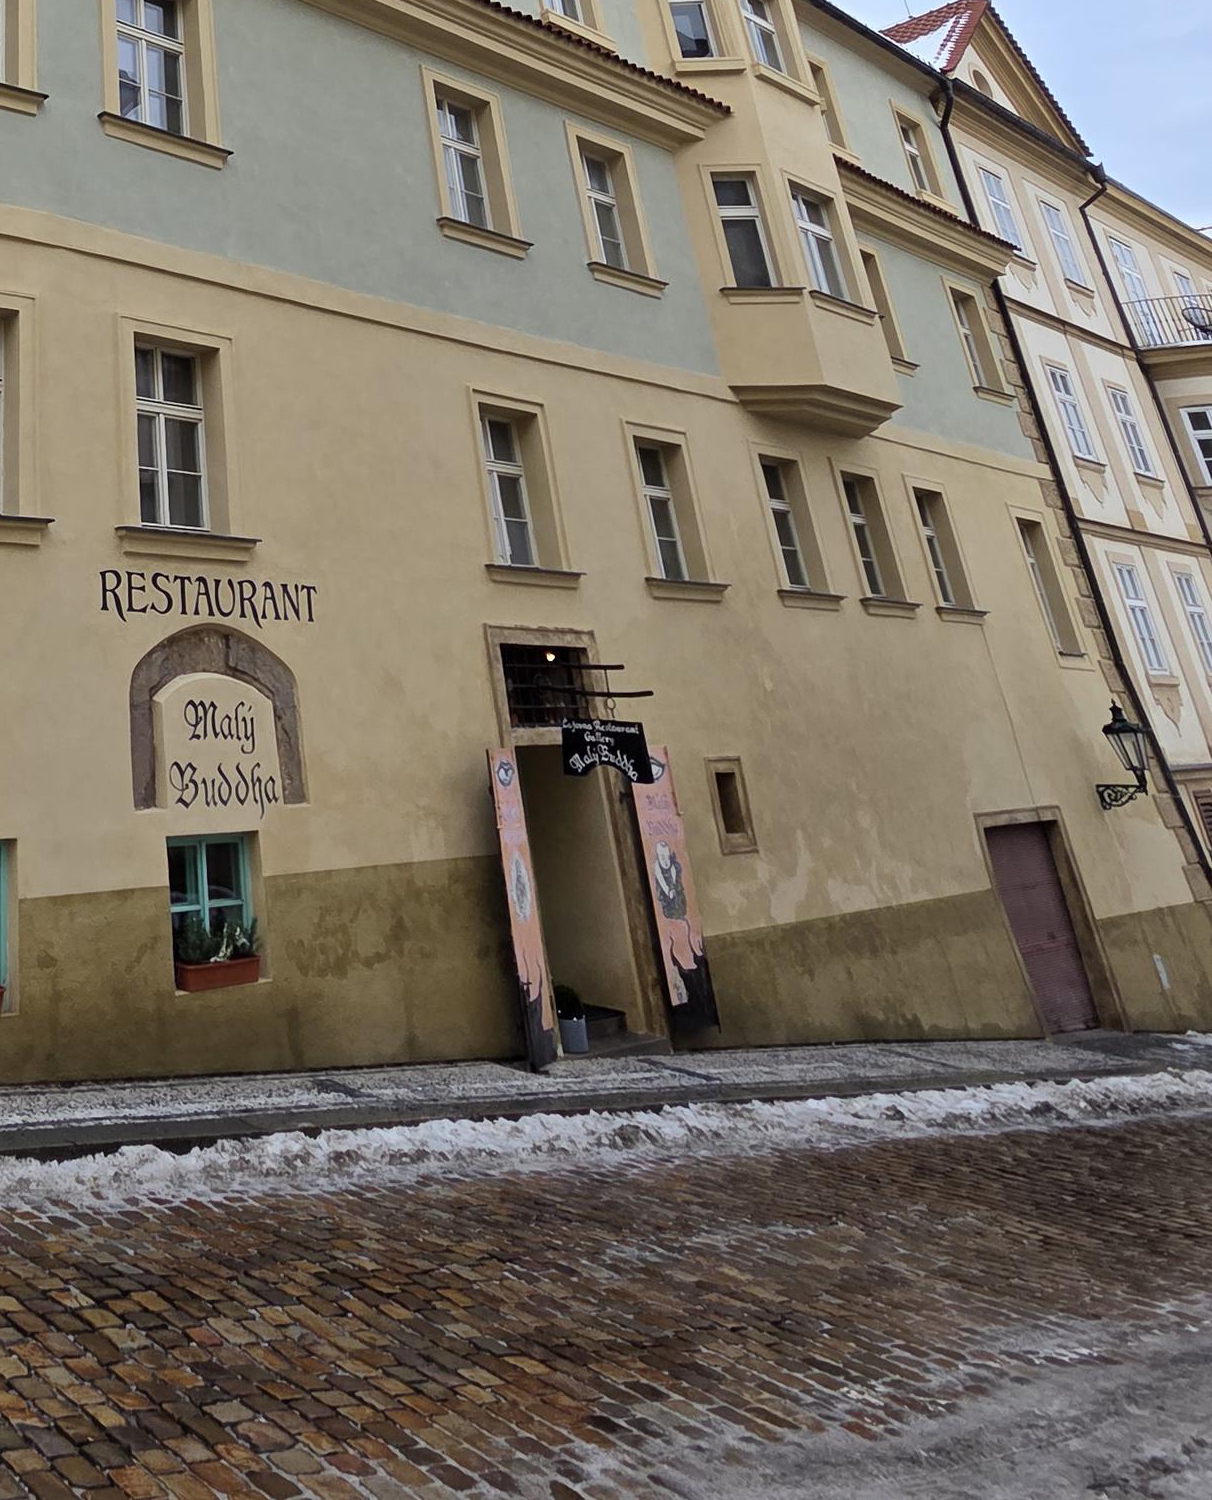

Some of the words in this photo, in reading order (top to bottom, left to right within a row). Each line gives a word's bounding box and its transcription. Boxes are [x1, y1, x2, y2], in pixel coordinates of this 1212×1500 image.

[99, 569, 317, 629] RESTAURANT
[184, 699, 255, 754] Malý
[584, 731, 614, 746] Gallery
[597, 744, 638, 781] Buddha
[169, 761, 279, 820] Buddha
